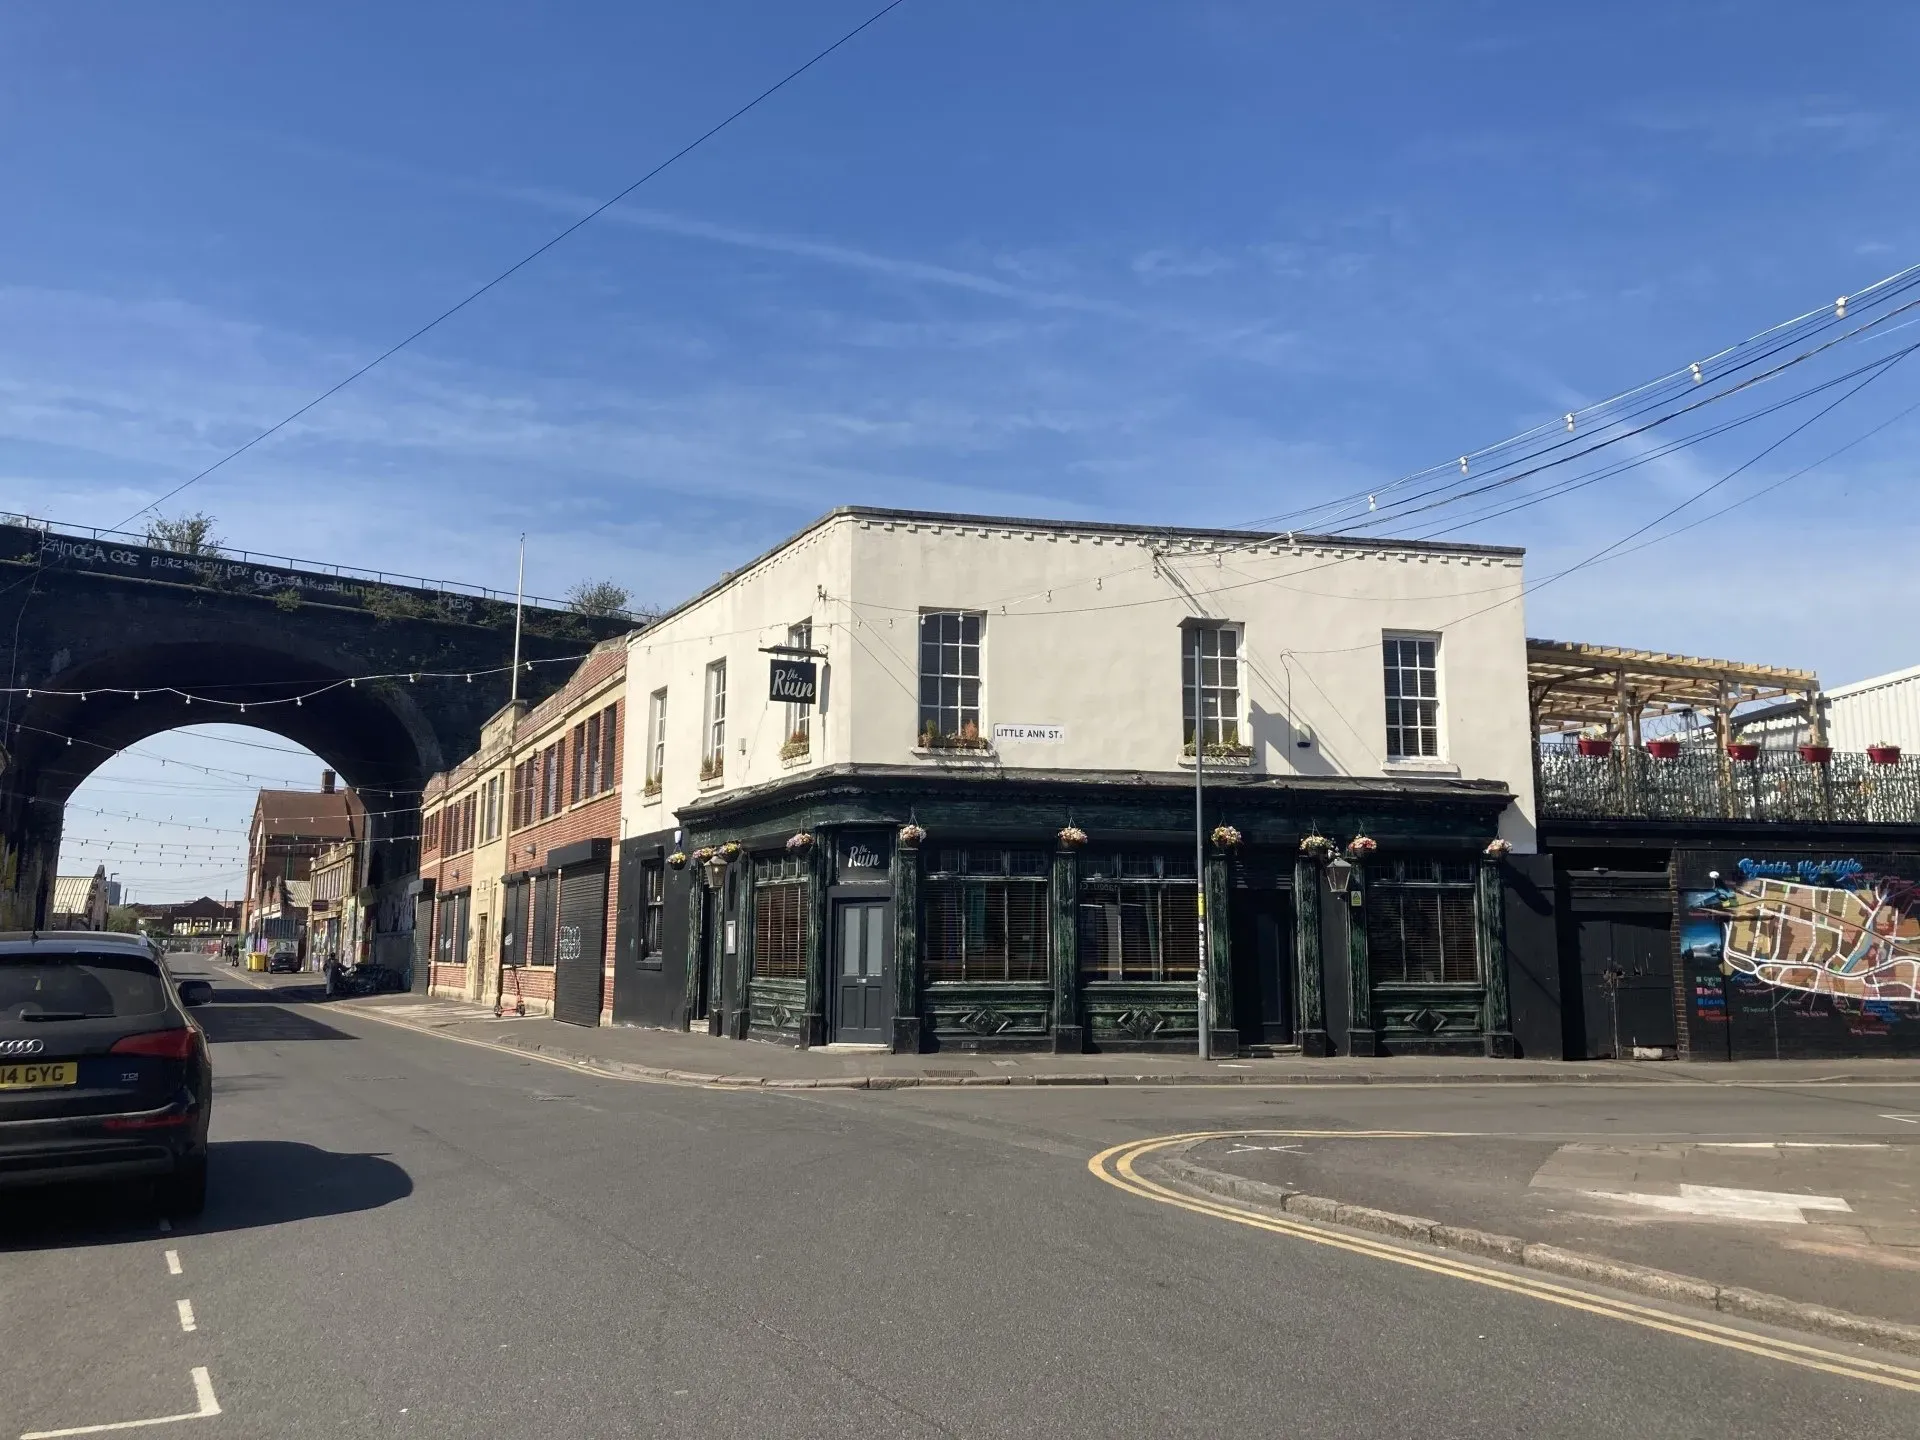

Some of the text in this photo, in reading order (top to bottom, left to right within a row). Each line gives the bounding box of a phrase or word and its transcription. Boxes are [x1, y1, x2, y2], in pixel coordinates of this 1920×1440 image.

[787, 668, 798, 681] the
[772, 669, 814, 698] Ruin
[996, 728, 1024, 738] LITTLE
[1027, 730, 1045, 738] ANN
[848, 846, 880, 868] Ruin
[25, 1065, 64, 1082] GYG
